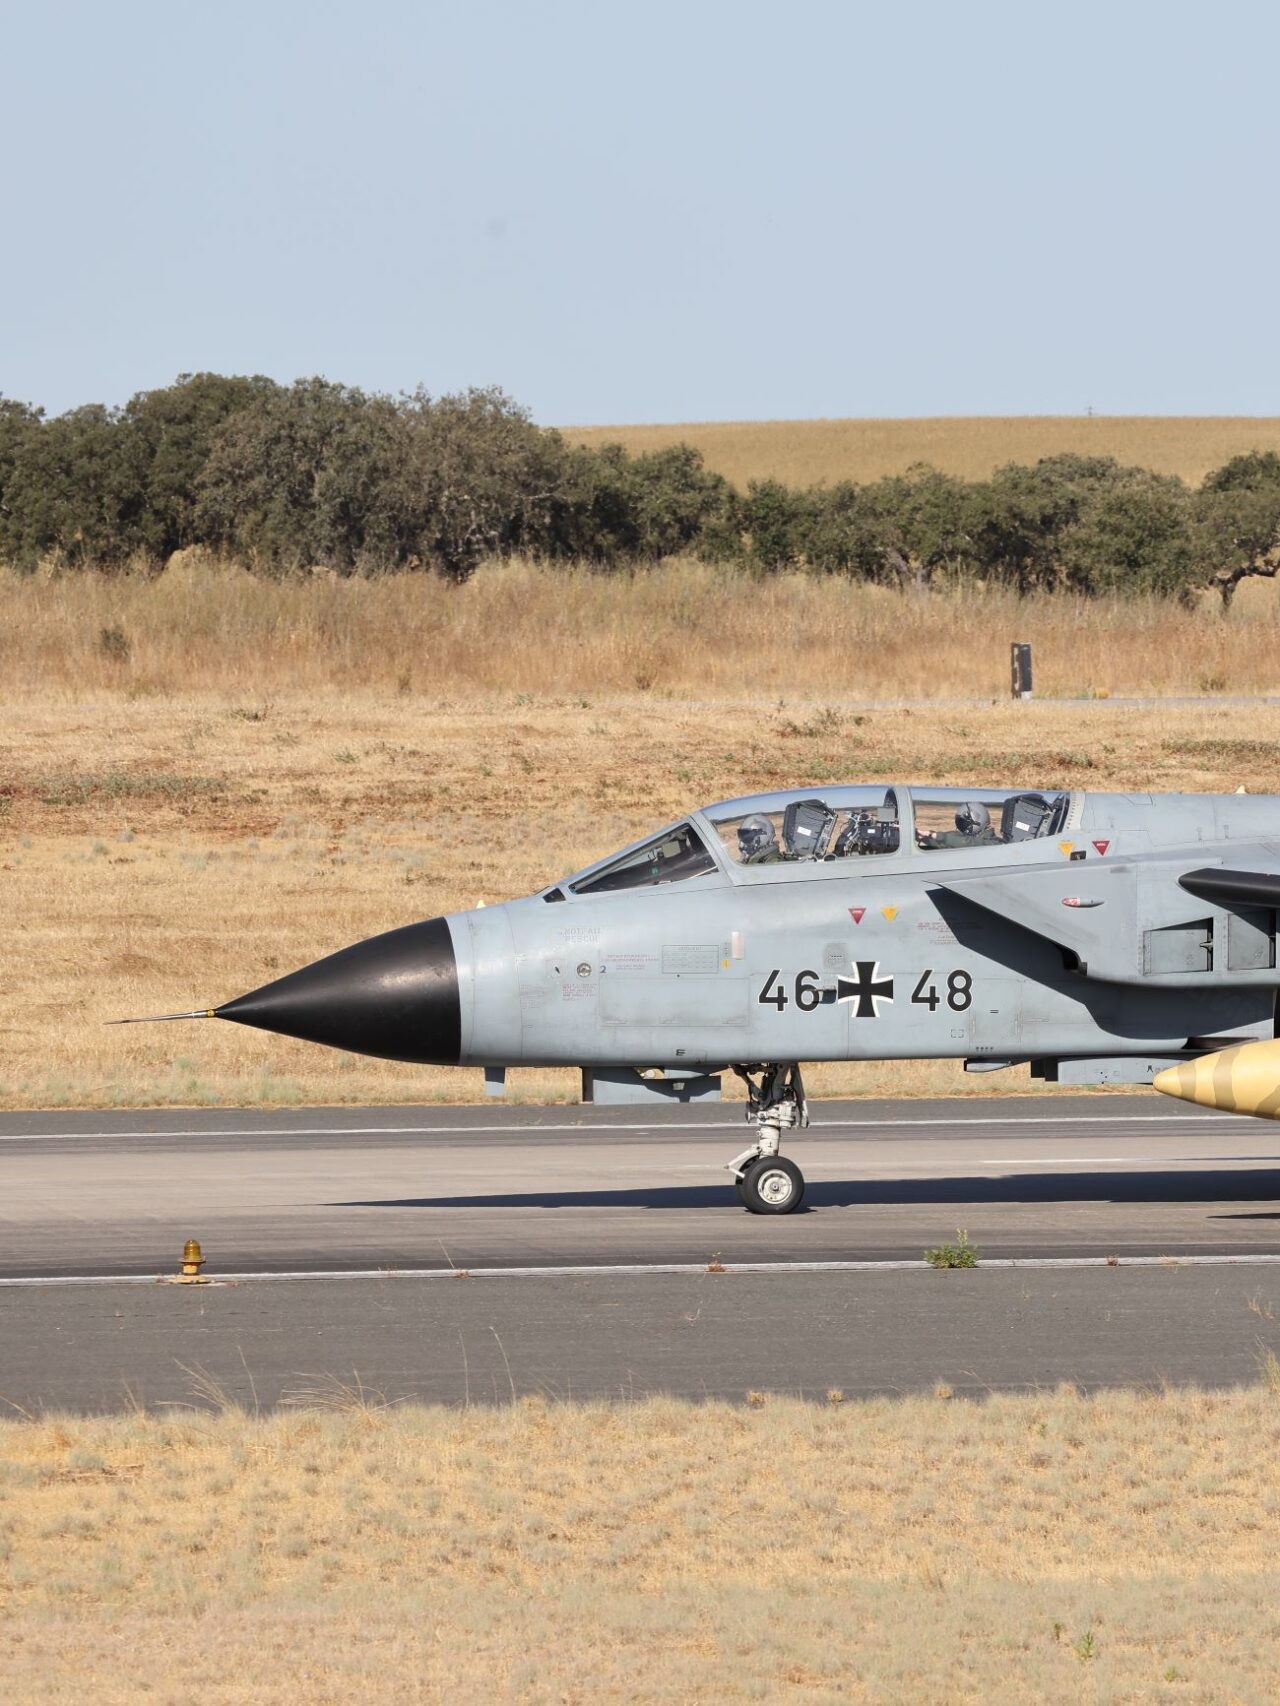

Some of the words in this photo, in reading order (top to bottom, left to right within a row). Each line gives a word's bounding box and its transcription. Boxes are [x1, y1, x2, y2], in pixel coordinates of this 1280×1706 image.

[600, 965, 608, 974] 2
[758, 969, 820, 1012] 46
[911, 969, 973, 1012] 48
